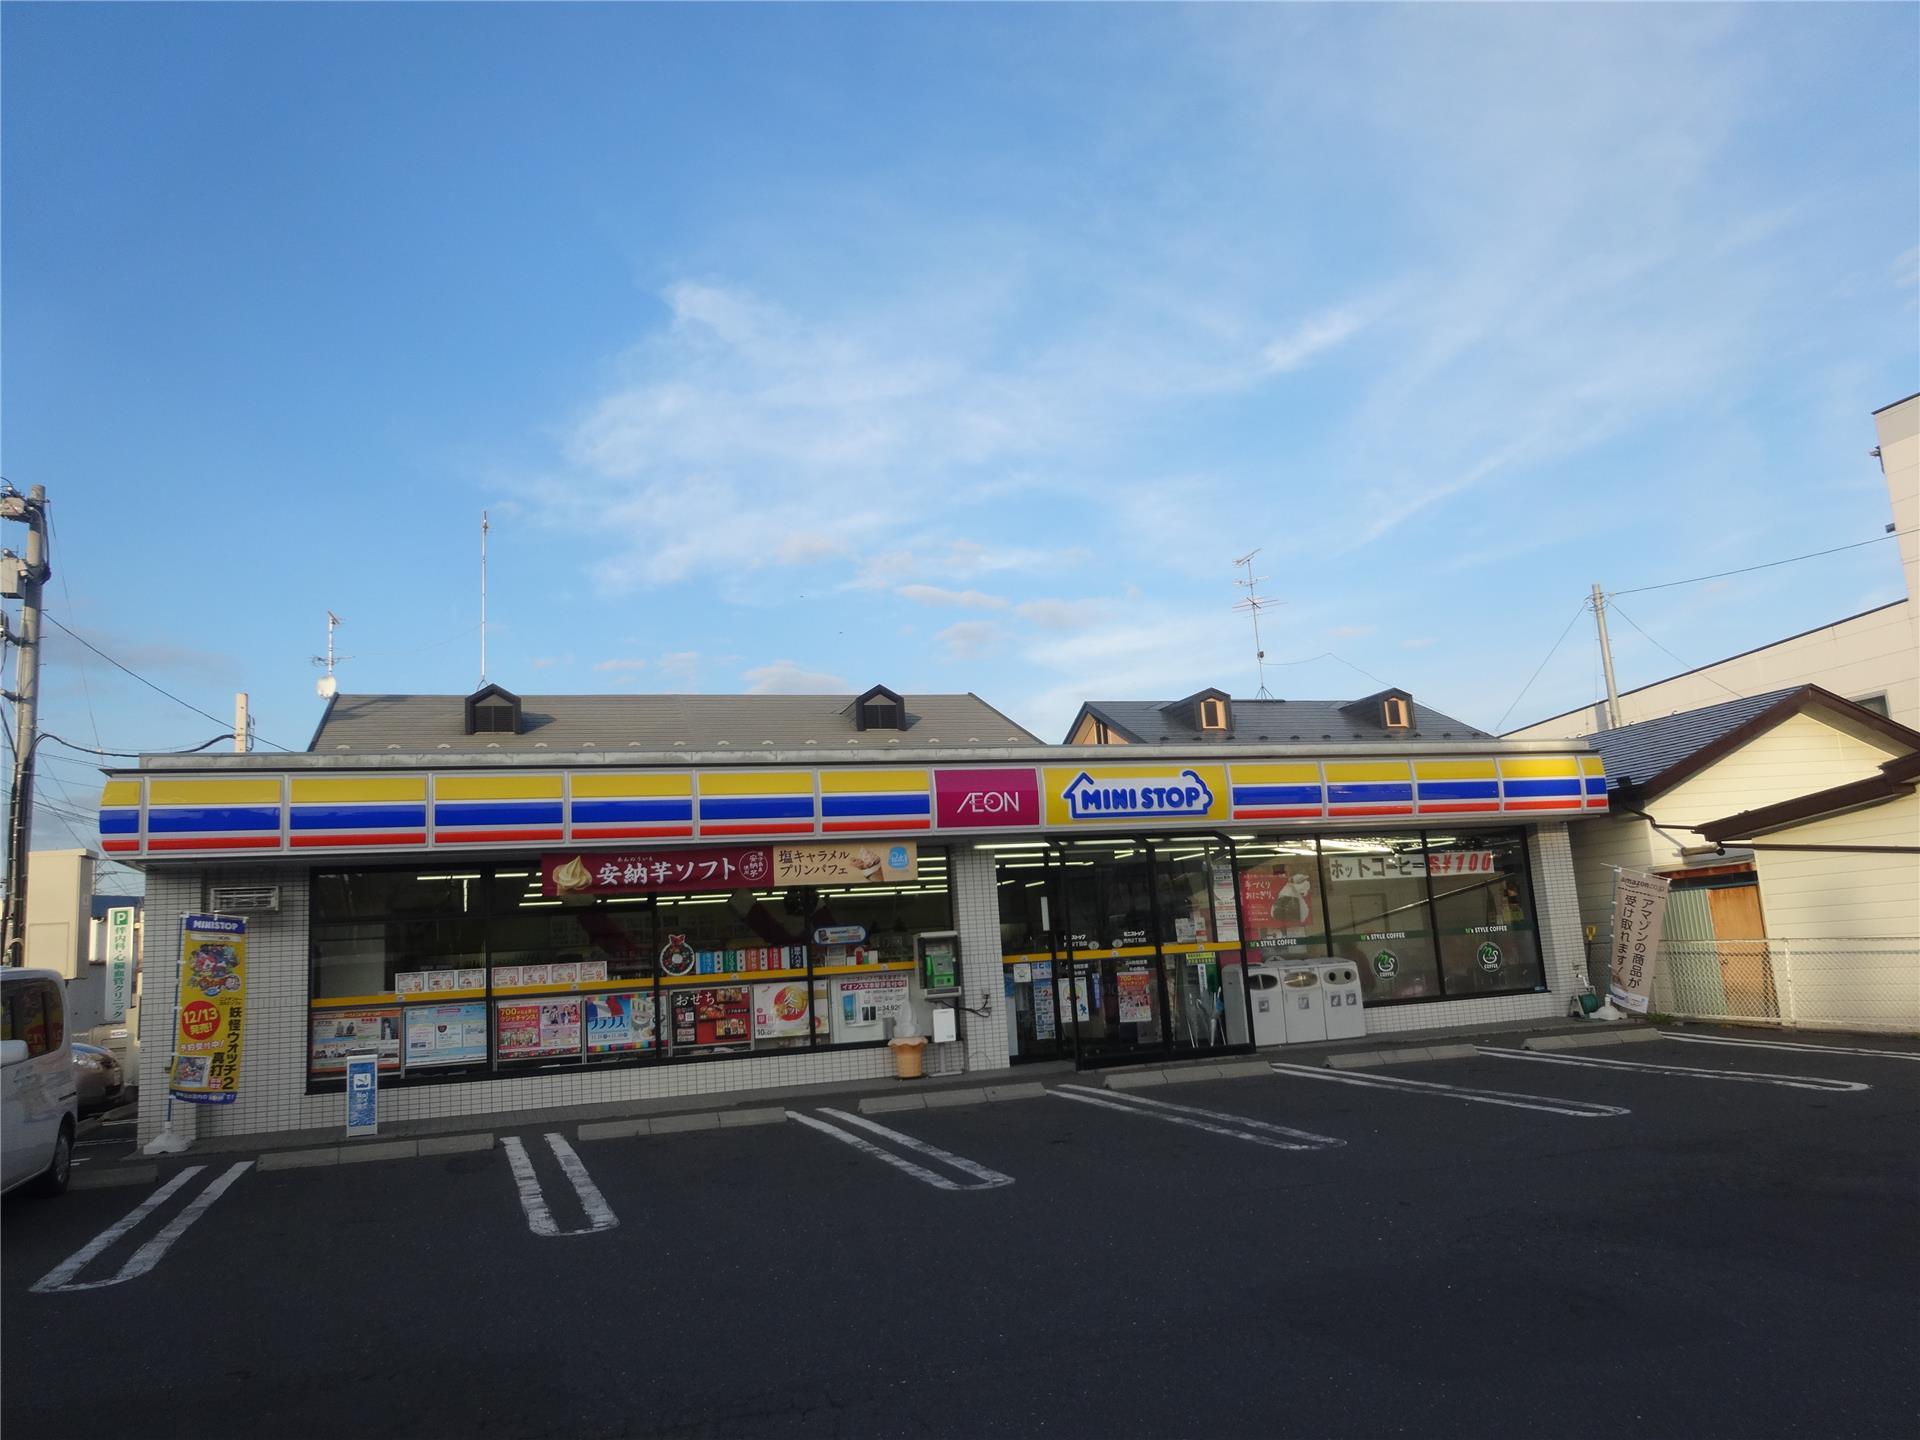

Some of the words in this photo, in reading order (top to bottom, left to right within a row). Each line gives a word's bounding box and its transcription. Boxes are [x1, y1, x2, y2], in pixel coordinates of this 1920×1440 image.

[1080, 788, 1137, 810] MINI
[1140, 786, 1200, 809] STOP
[779, 850, 849, 863] 塩キャラメル
[596, 857, 736, 886] 安納芋ソフト
[779, 864, 849, 878] プリンパフェ
[1331, 857, 1425, 879] ホットコーヒー
[193, 919, 238, 930] MINISTOP
[1475, 926, 1489, 934] STYLE
[1277, 938, 1296, 946] COFFEE
[1370, 933, 1385, 941] STYLE
[1386, 932, 1405, 940] COFFEE
[1627, 898, 1654, 990] アマゾンの商品が
[676, 992, 715, 1006] おせち
[183, 1007, 218, 1024] 12/13
[190, 1022, 213, 1035] 発売!
[210, 1051, 225, 1077] 真打
